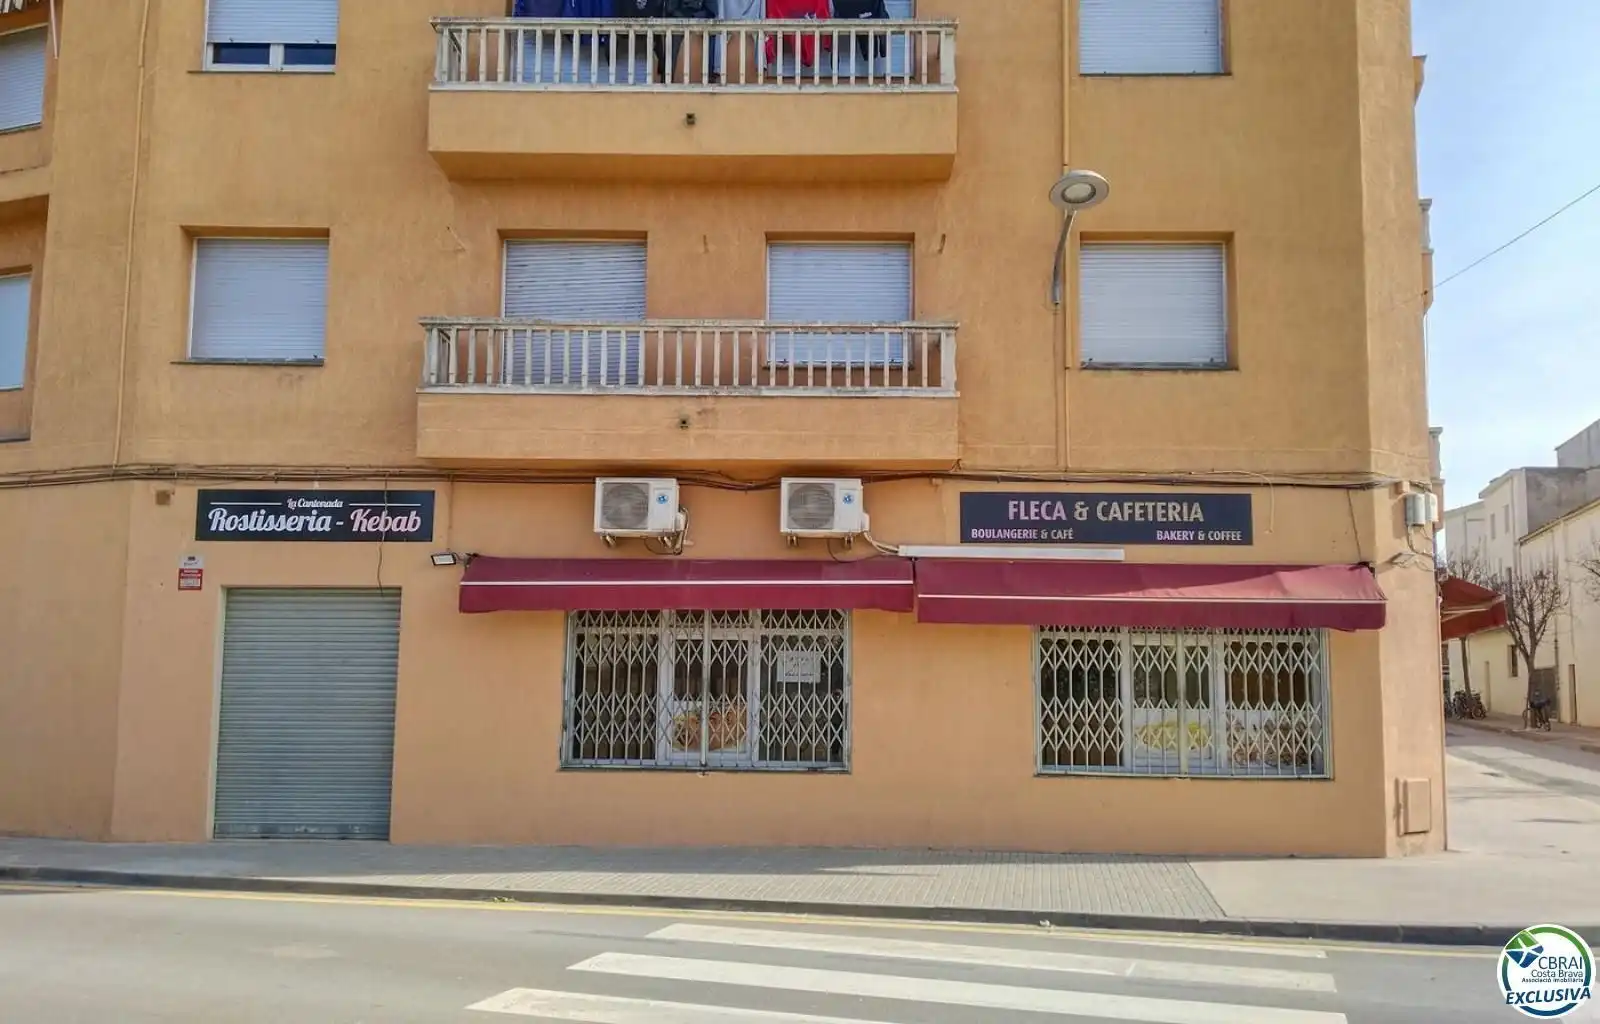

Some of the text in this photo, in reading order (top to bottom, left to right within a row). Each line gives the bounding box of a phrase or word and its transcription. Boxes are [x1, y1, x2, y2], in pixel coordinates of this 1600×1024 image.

[286, 498, 343, 510] La Cantonada
[1008, 500, 1205, 523] FLECA & CAFETERIA
[208, 508, 332, 533] Rostisseria
[350, 509, 422, 533] Kebab
[971, 528, 1074, 540] BOULANGERIE & CAFÉ
[1156, 530, 1242, 542] BAKERY & COFFEE
